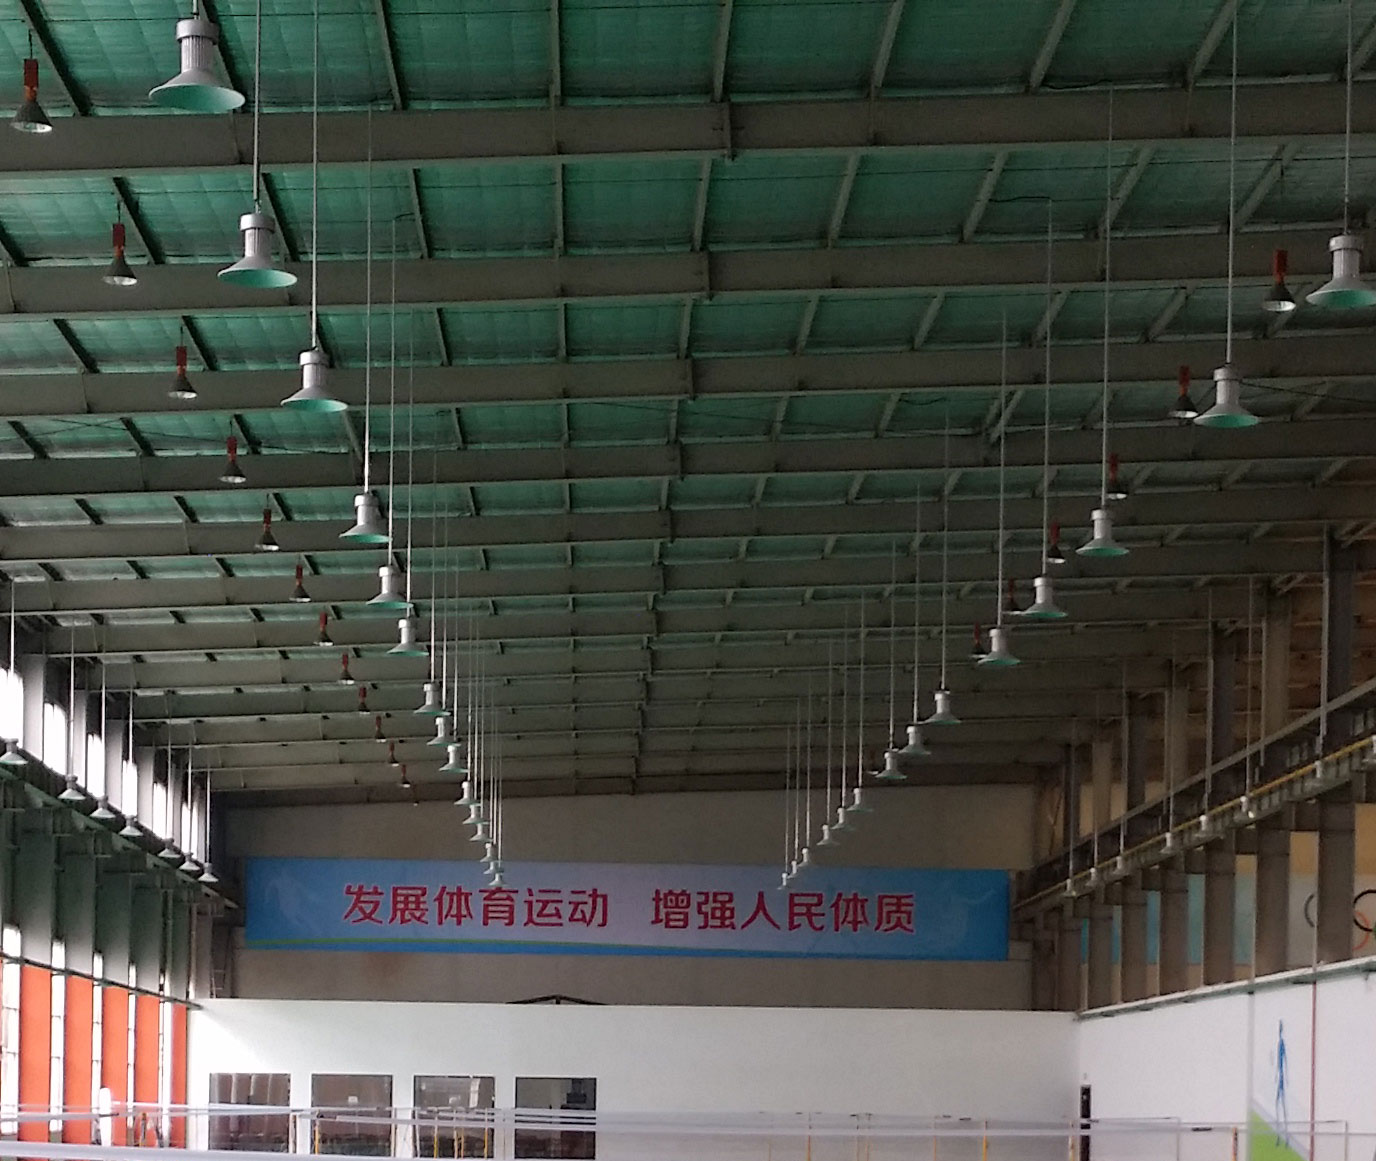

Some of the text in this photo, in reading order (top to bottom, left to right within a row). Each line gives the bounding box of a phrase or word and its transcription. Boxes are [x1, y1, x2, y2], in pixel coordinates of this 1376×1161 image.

[342, 884, 915, 933] 发展体育运动 增强人民体质
